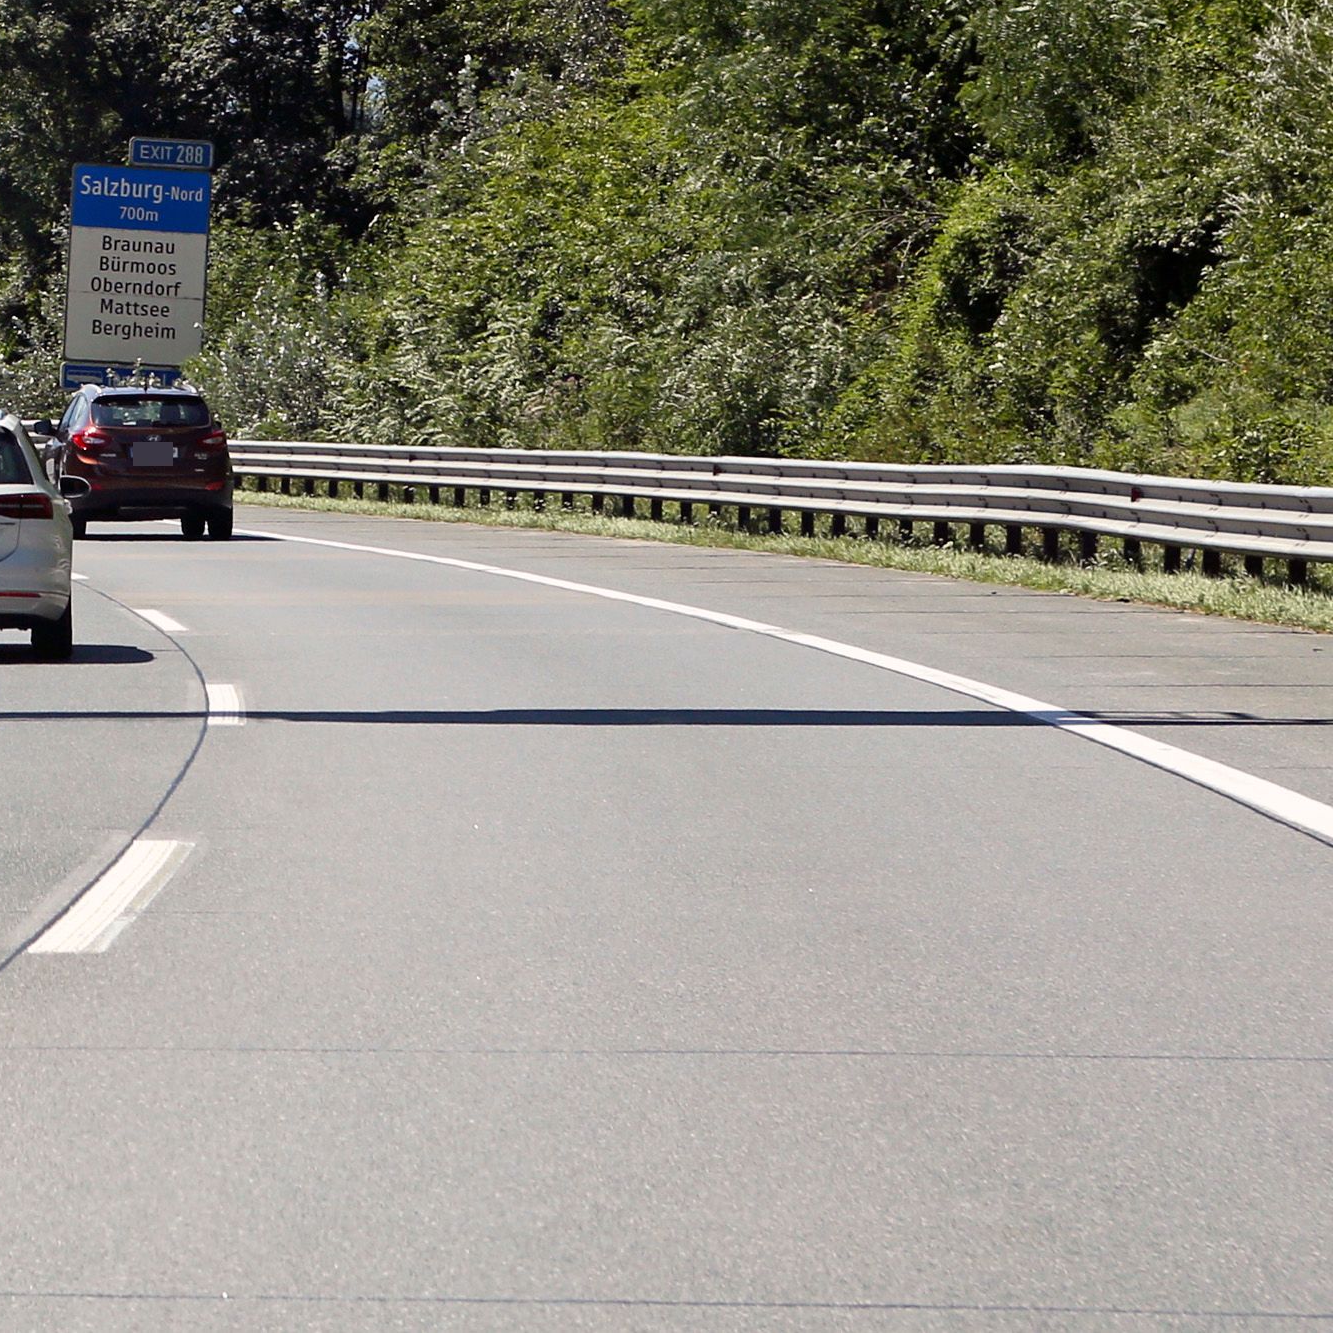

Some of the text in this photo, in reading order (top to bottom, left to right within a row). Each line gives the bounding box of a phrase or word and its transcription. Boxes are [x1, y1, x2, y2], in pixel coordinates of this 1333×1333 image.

[140, 144, 204, 164] EXIT 288
[79, 174, 204, 204] Salzburg-Nord
[119, 206, 159, 222] 700m
[101, 235, 175, 254] Braunau
[99, 256, 177, 275] Bürmoos
[90, 276, 182, 297] Oberndorf
[100, 298, 170, 318] Mattsee
[91, 319, 176, 340] Bergheim
